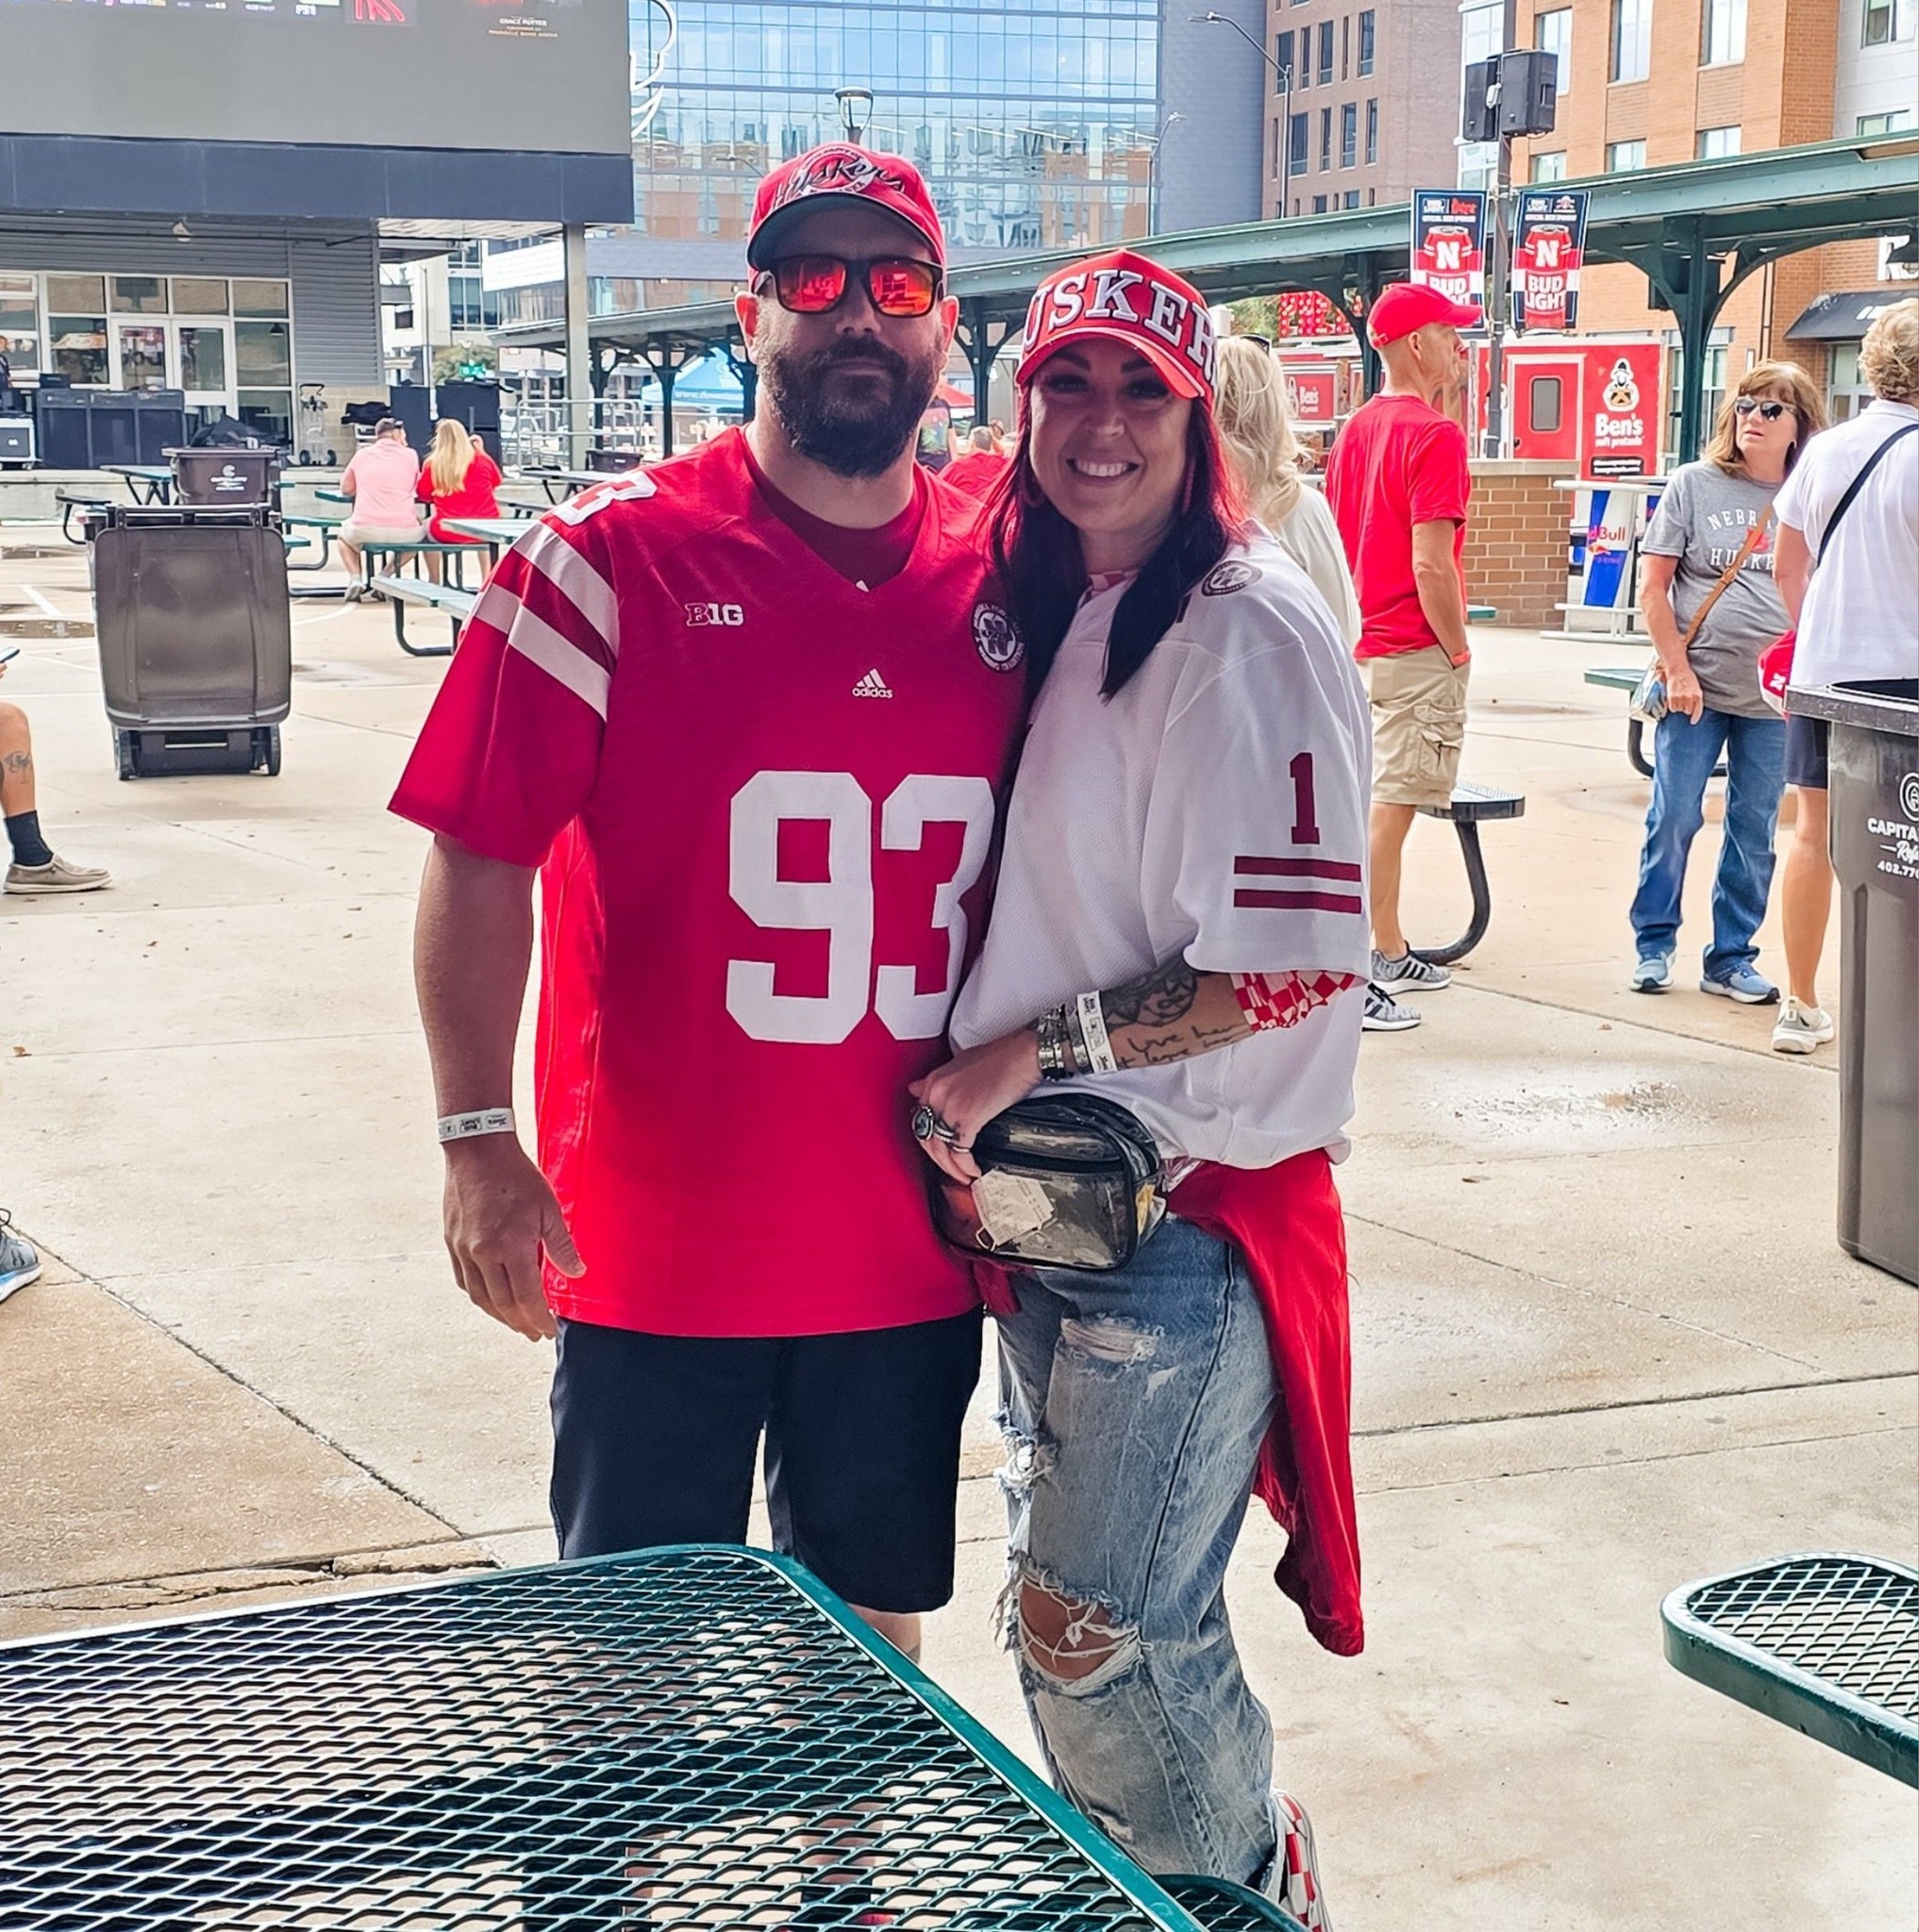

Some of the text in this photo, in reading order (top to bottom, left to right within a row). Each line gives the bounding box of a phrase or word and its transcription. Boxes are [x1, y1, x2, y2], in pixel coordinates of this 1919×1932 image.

[1436, 241, 1460, 270] N
[1535, 239, 1560, 268] N
[1528, 274, 1563, 293] BUD
[1524, 289, 1566, 310] LIGHT
[1023, 269, 1220, 387] USKER
[1594, 412, 1644, 438] Ben's
[1710, 547, 1774, 571] HUKE
[852, 686, 893, 699] adidas
[1289, 752, 1321, 845] 1
[726, 770, 995, 1044] 93
